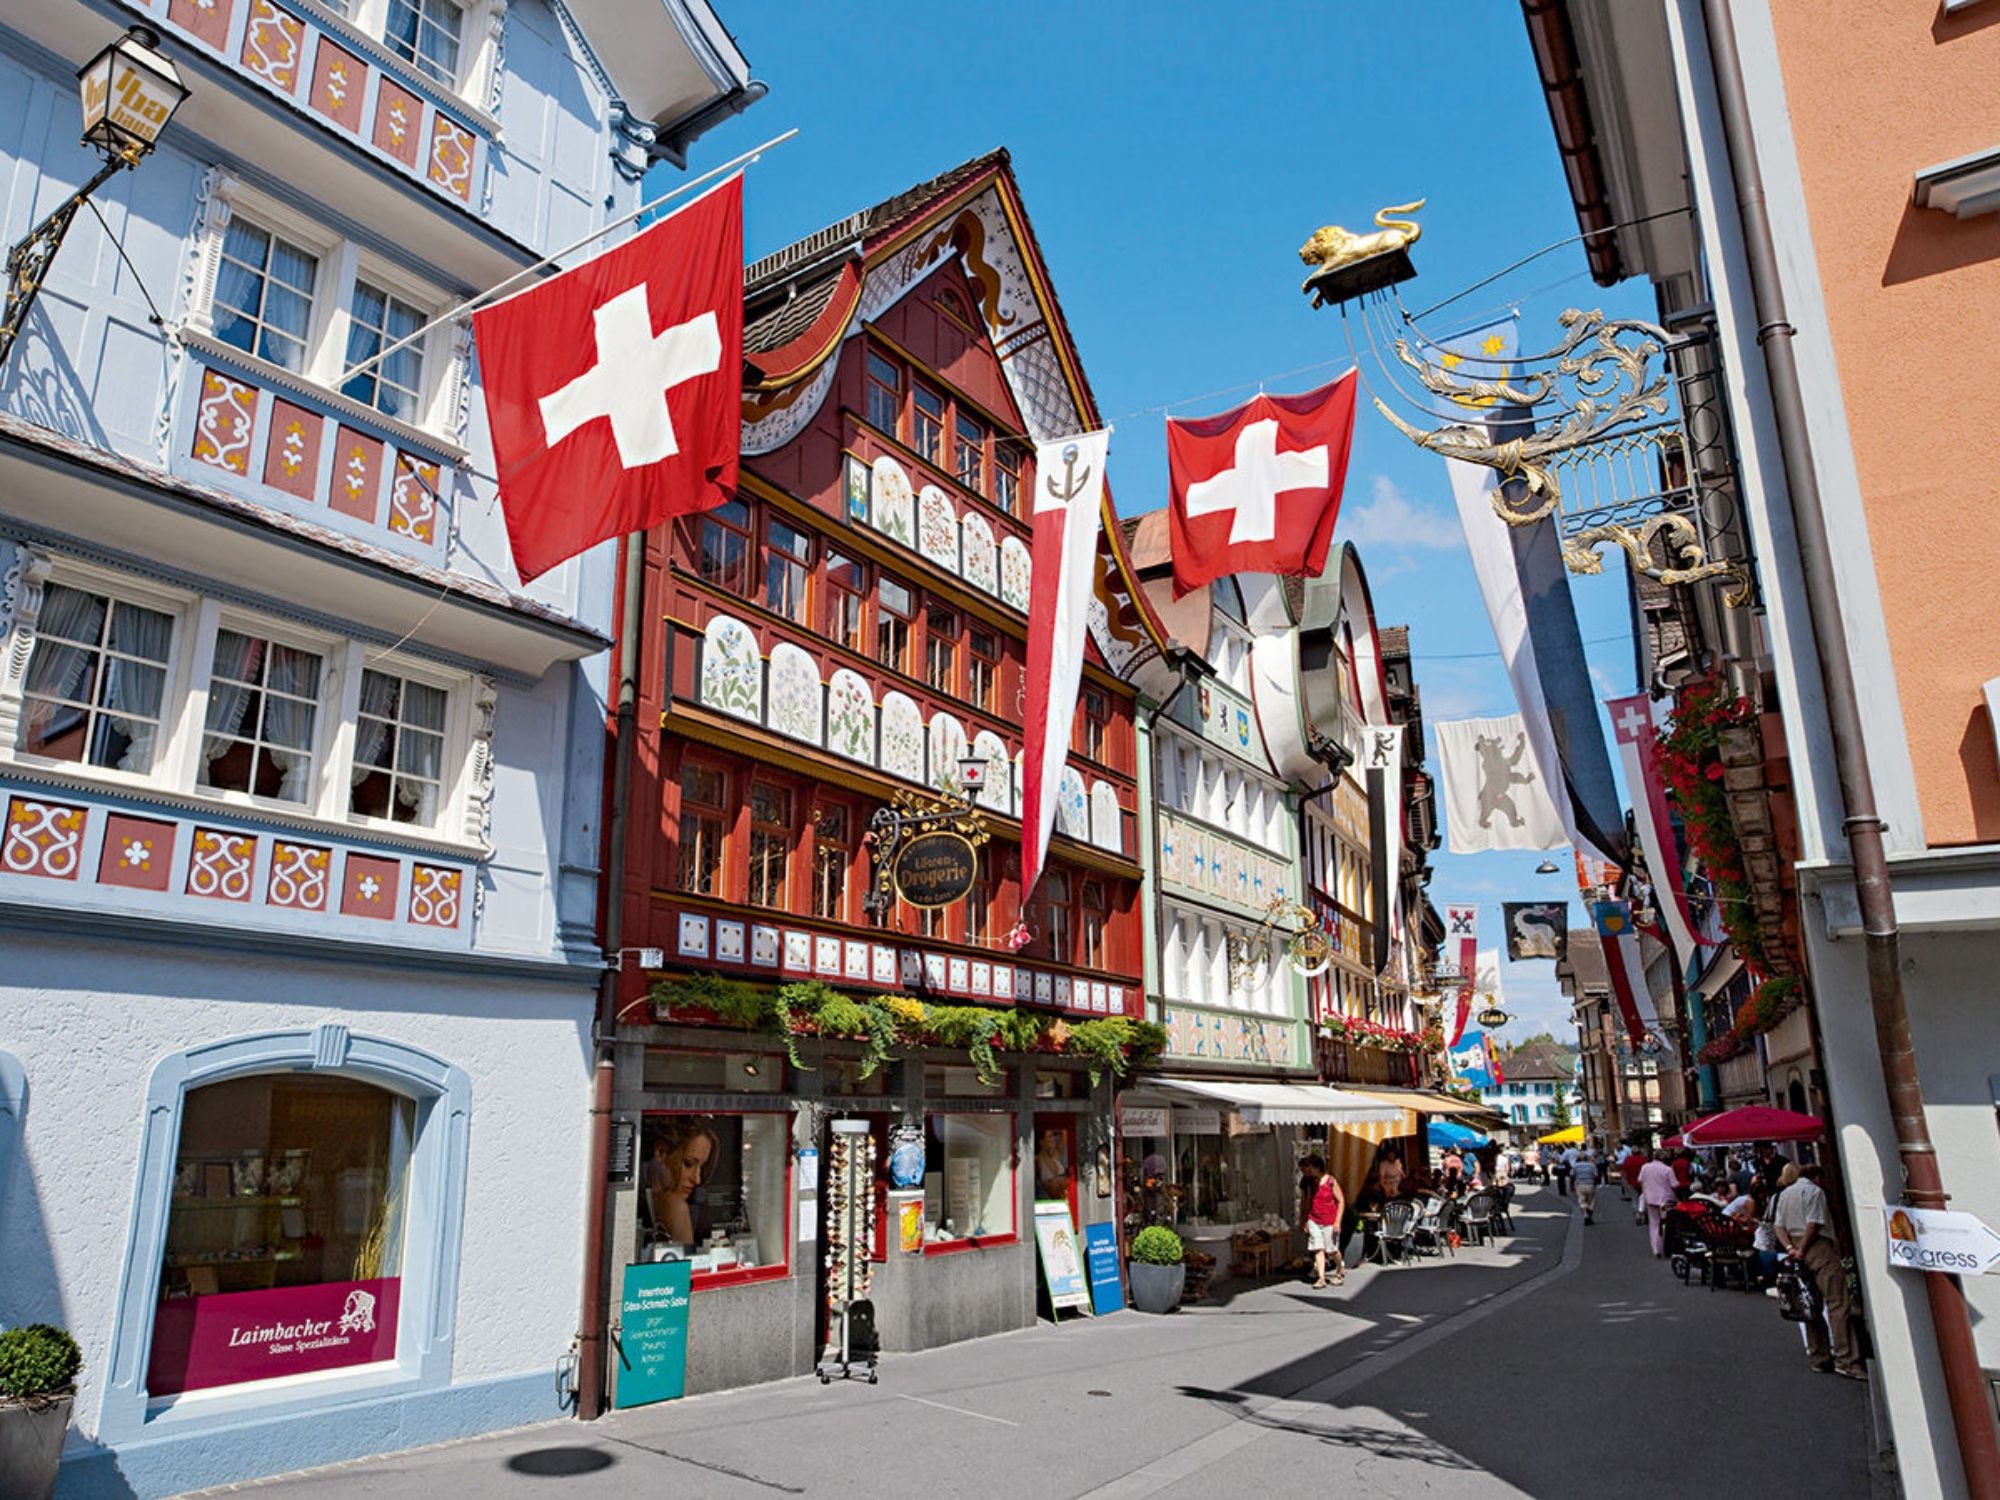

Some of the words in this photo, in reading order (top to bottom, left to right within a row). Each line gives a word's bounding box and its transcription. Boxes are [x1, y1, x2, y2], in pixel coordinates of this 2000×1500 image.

[111, 105, 157, 140] haus
[901, 861, 968, 889] Drogerie
[1891, 1242, 1978, 1269] Kogress
[228, 1318, 332, 1347] Laimbacher
